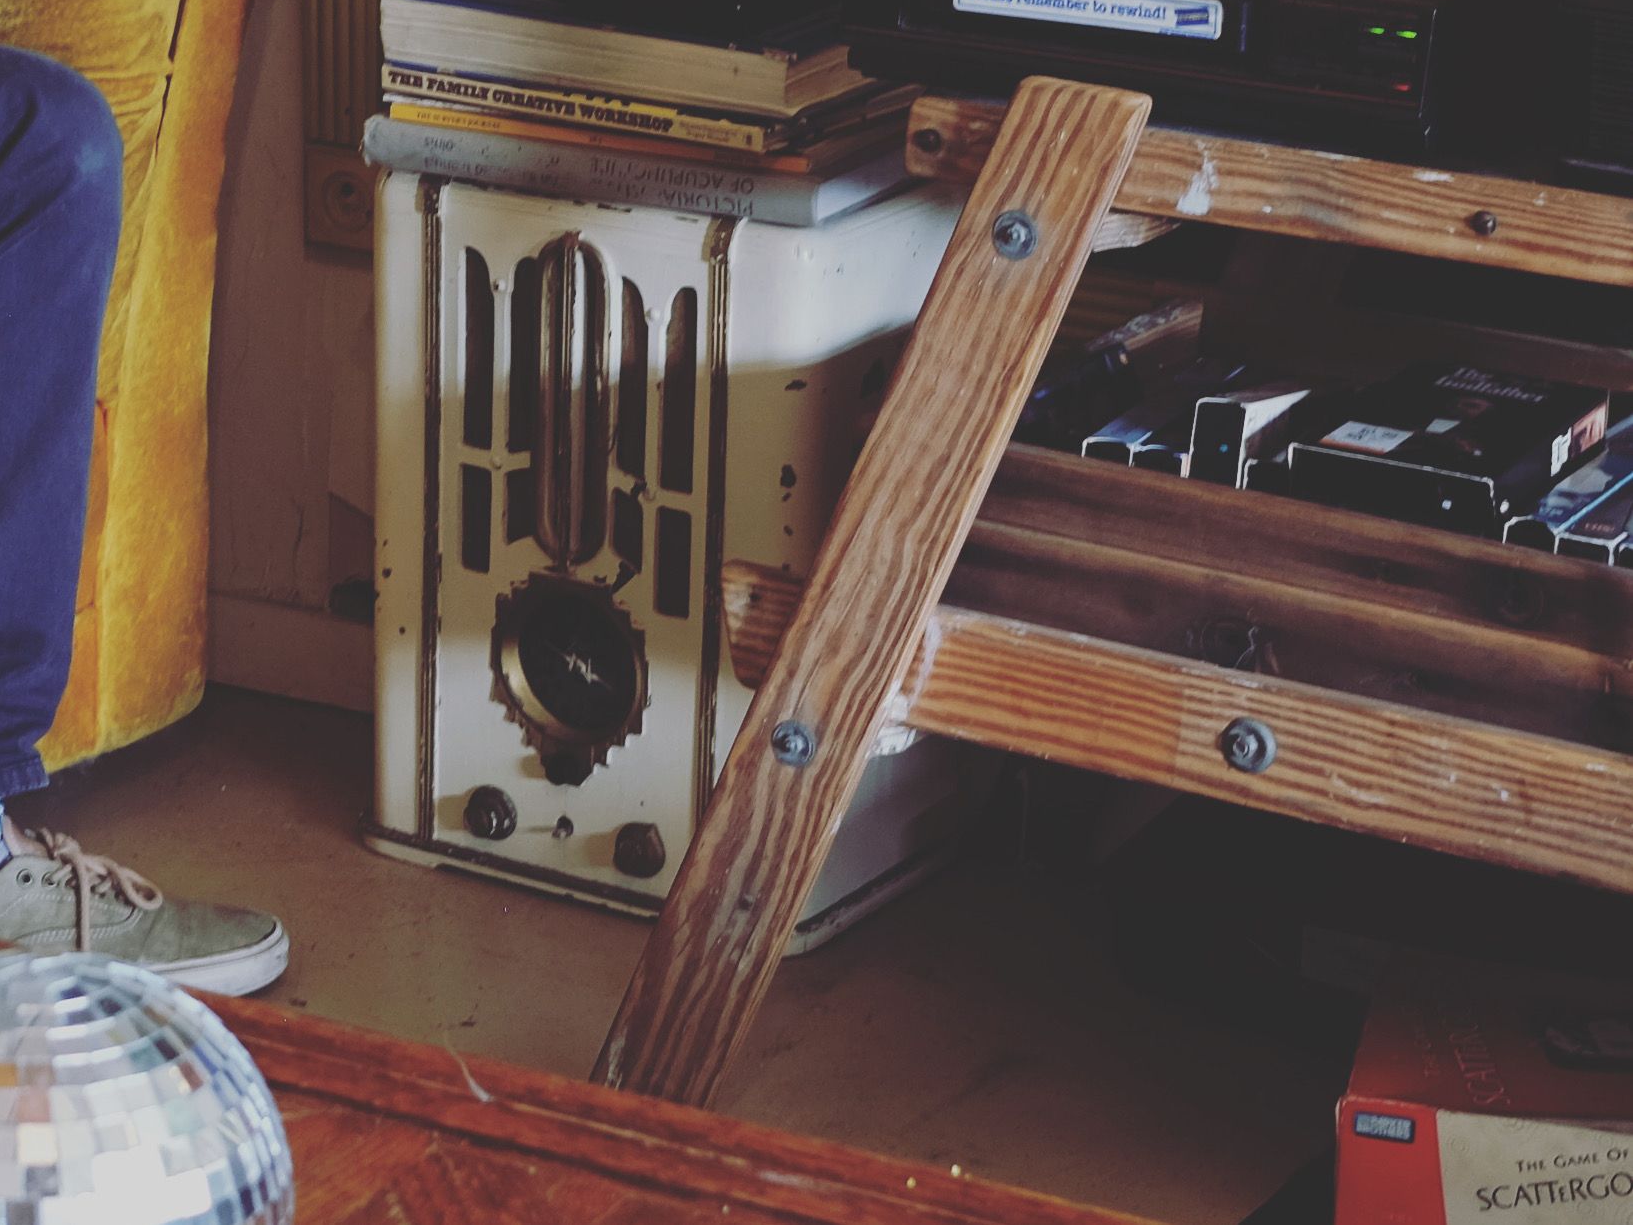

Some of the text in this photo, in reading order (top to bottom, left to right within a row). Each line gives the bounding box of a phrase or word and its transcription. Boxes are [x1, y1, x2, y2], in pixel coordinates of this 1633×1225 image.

[1091, 0, 1107, 14] to
[1109, 4, 1167, 21] rewind!
[387, 70, 424, 87] THE
[426, 77, 489, 102] FAMILY
[491, 88, 576, 118] CREATIVE
[578, 101, 674, 133] WORKSHOP
[730, 175, 756, 193] OF
[1515, 1147, 1630, 1174] THE GAME OF
